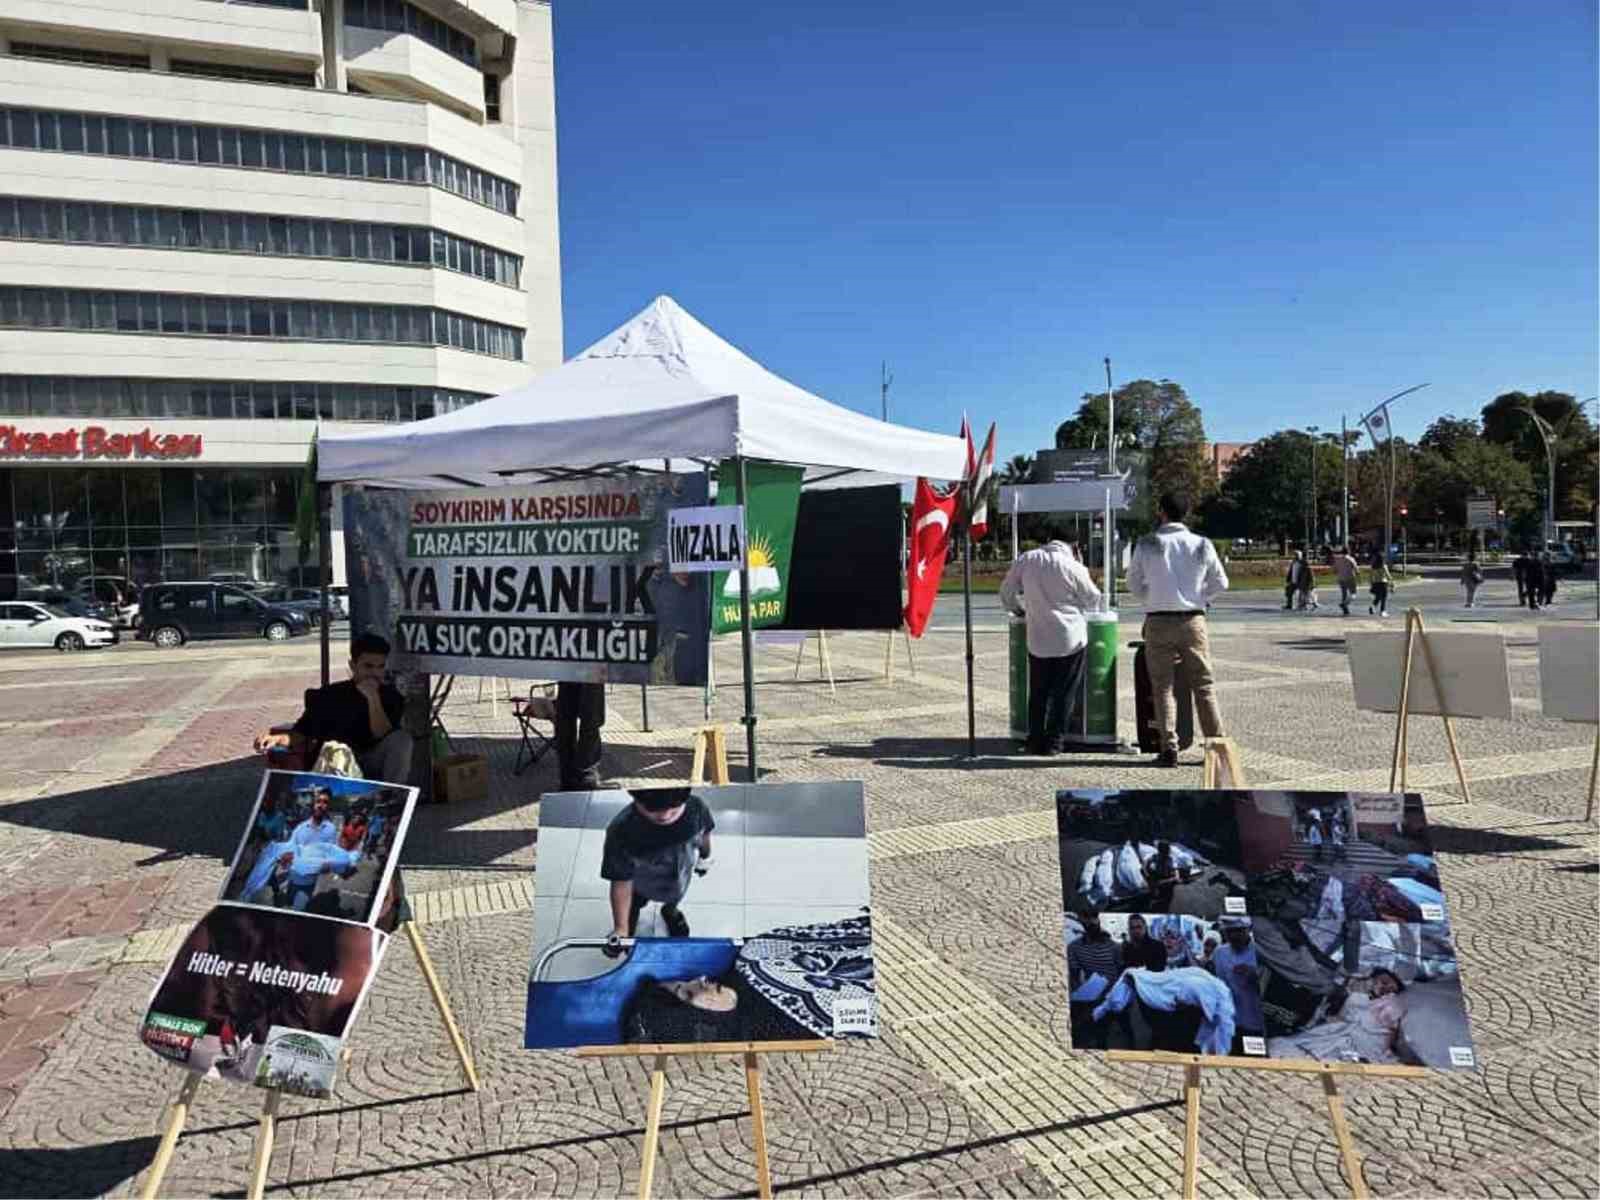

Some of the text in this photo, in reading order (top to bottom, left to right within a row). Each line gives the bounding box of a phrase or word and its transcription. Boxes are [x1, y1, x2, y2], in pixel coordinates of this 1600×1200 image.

[412, 491, 642, 524] SOYKIRIM KARŞISINDA
[412, 526, 641, 556] TARAFSIZLIK YOKTUR:
[670, 517, 742, 564] İMZALA
[395, 564, 660, 616] YA İNSANLIK
[401, 621, 647, 662] YA SUÇ ORTAKLIĞI!
[187, 953, 233, 977] Hitler
[248, 961, 344, 994] Netenyahu
